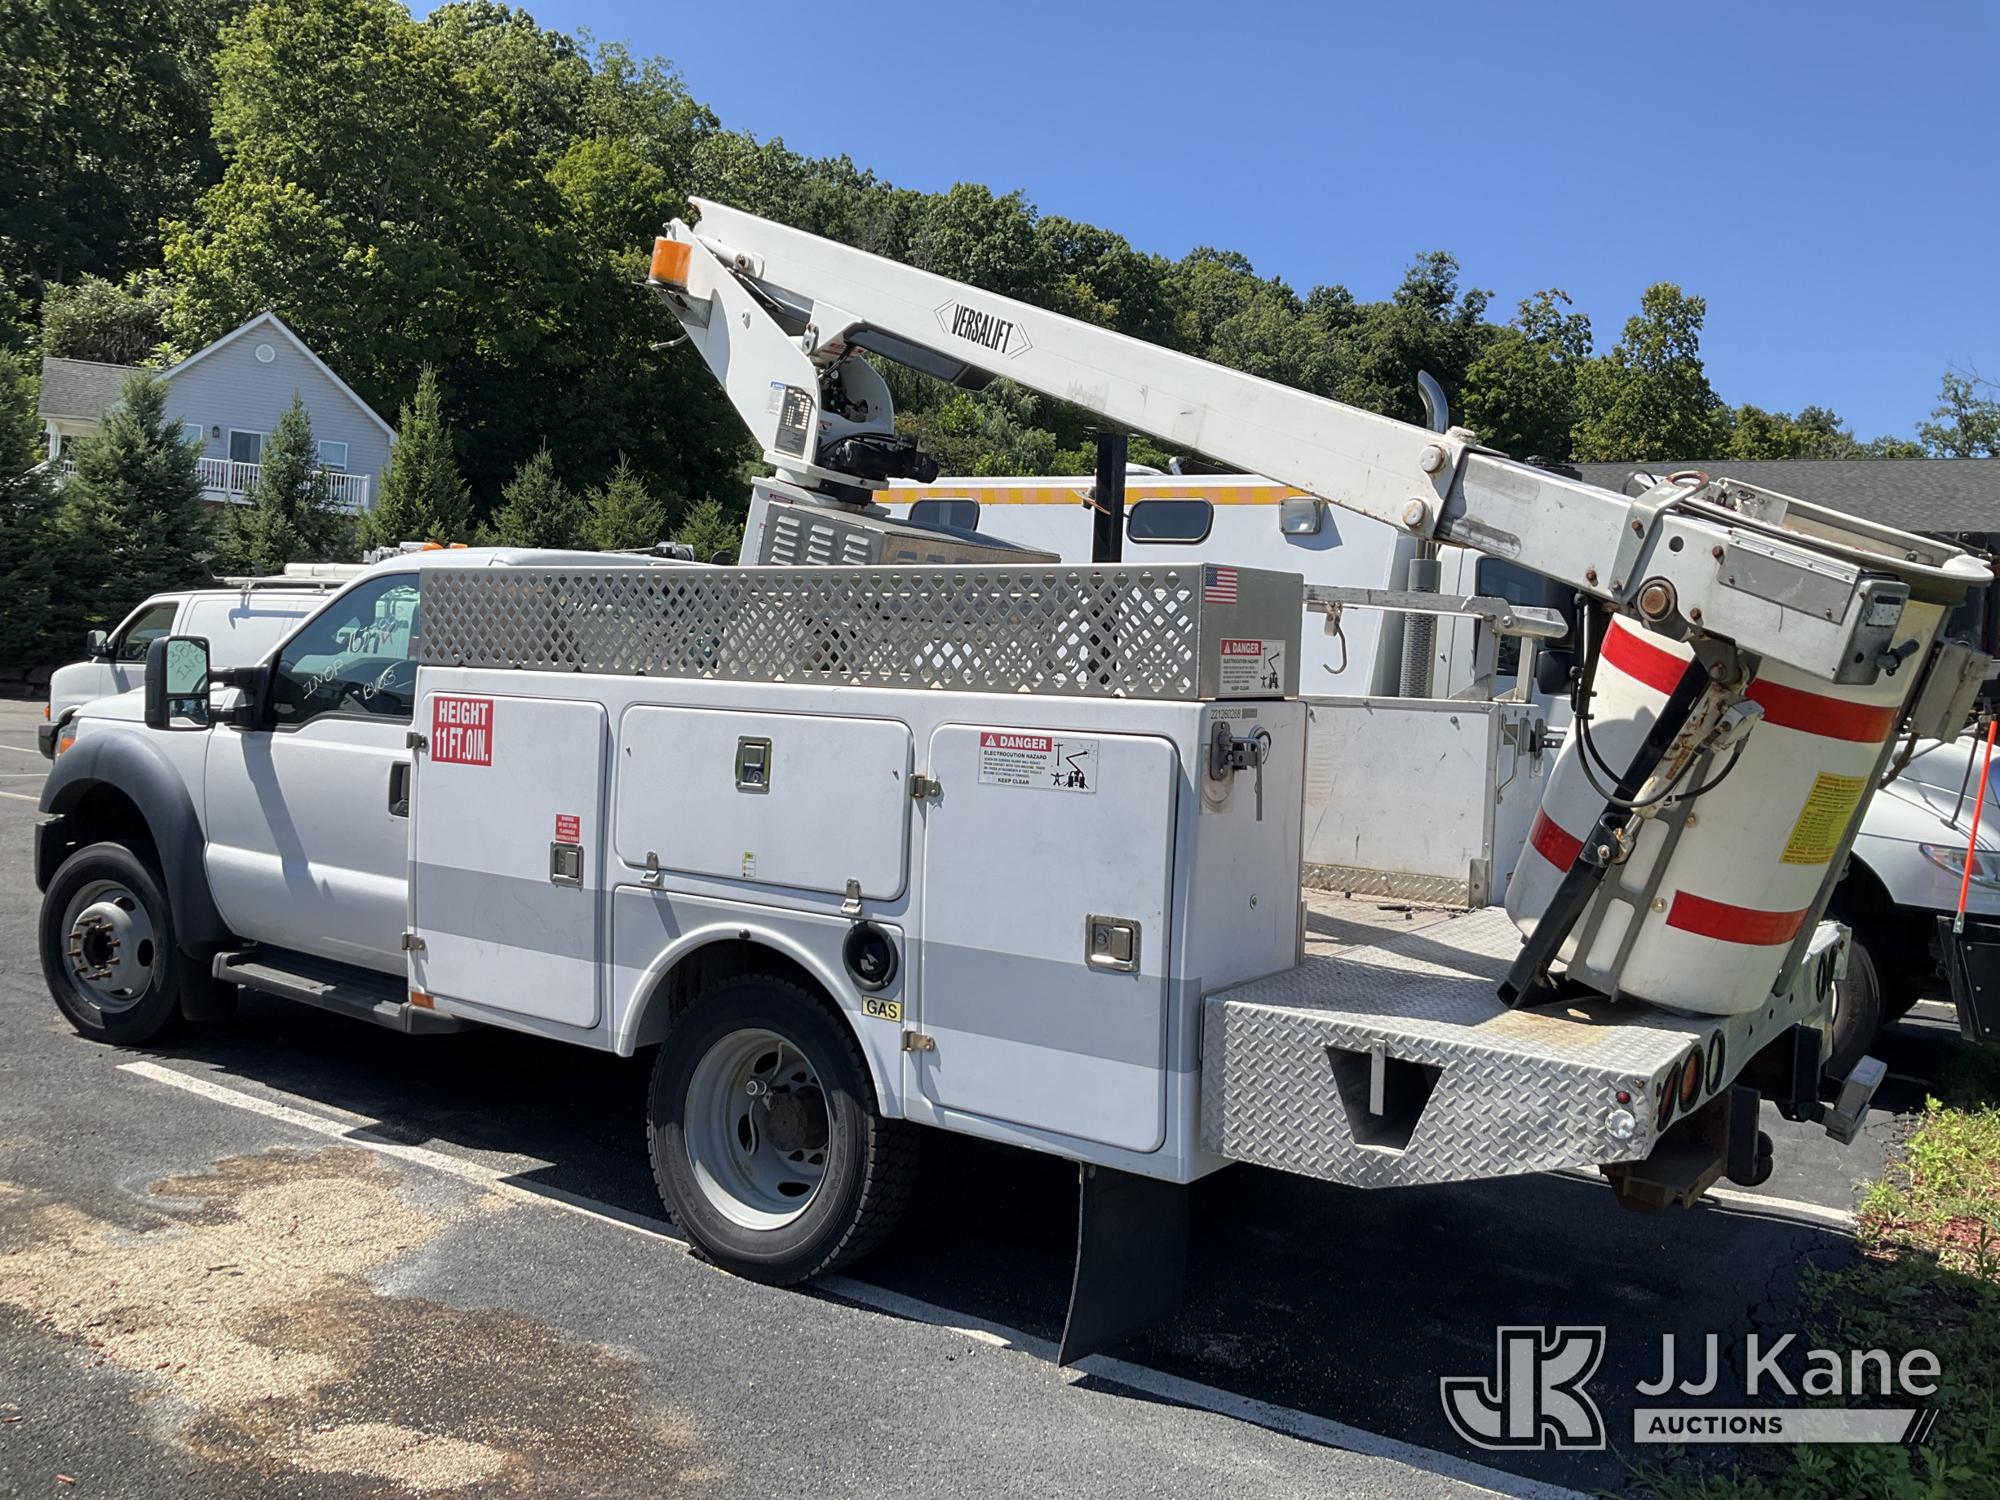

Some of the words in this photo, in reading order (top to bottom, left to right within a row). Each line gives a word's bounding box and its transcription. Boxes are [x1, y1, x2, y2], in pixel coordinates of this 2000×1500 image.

[951, 304, 1014, 354] VERSALIFT
[1232, 642, 1259, 654] DANGER
[438, 700, 489, 726] HEIGHT
[999, 736, 1047, 750] DANGER
[983, 750, 1026, 759] ELECTROCUTION
[866, 999, 898, 1019] GAS
